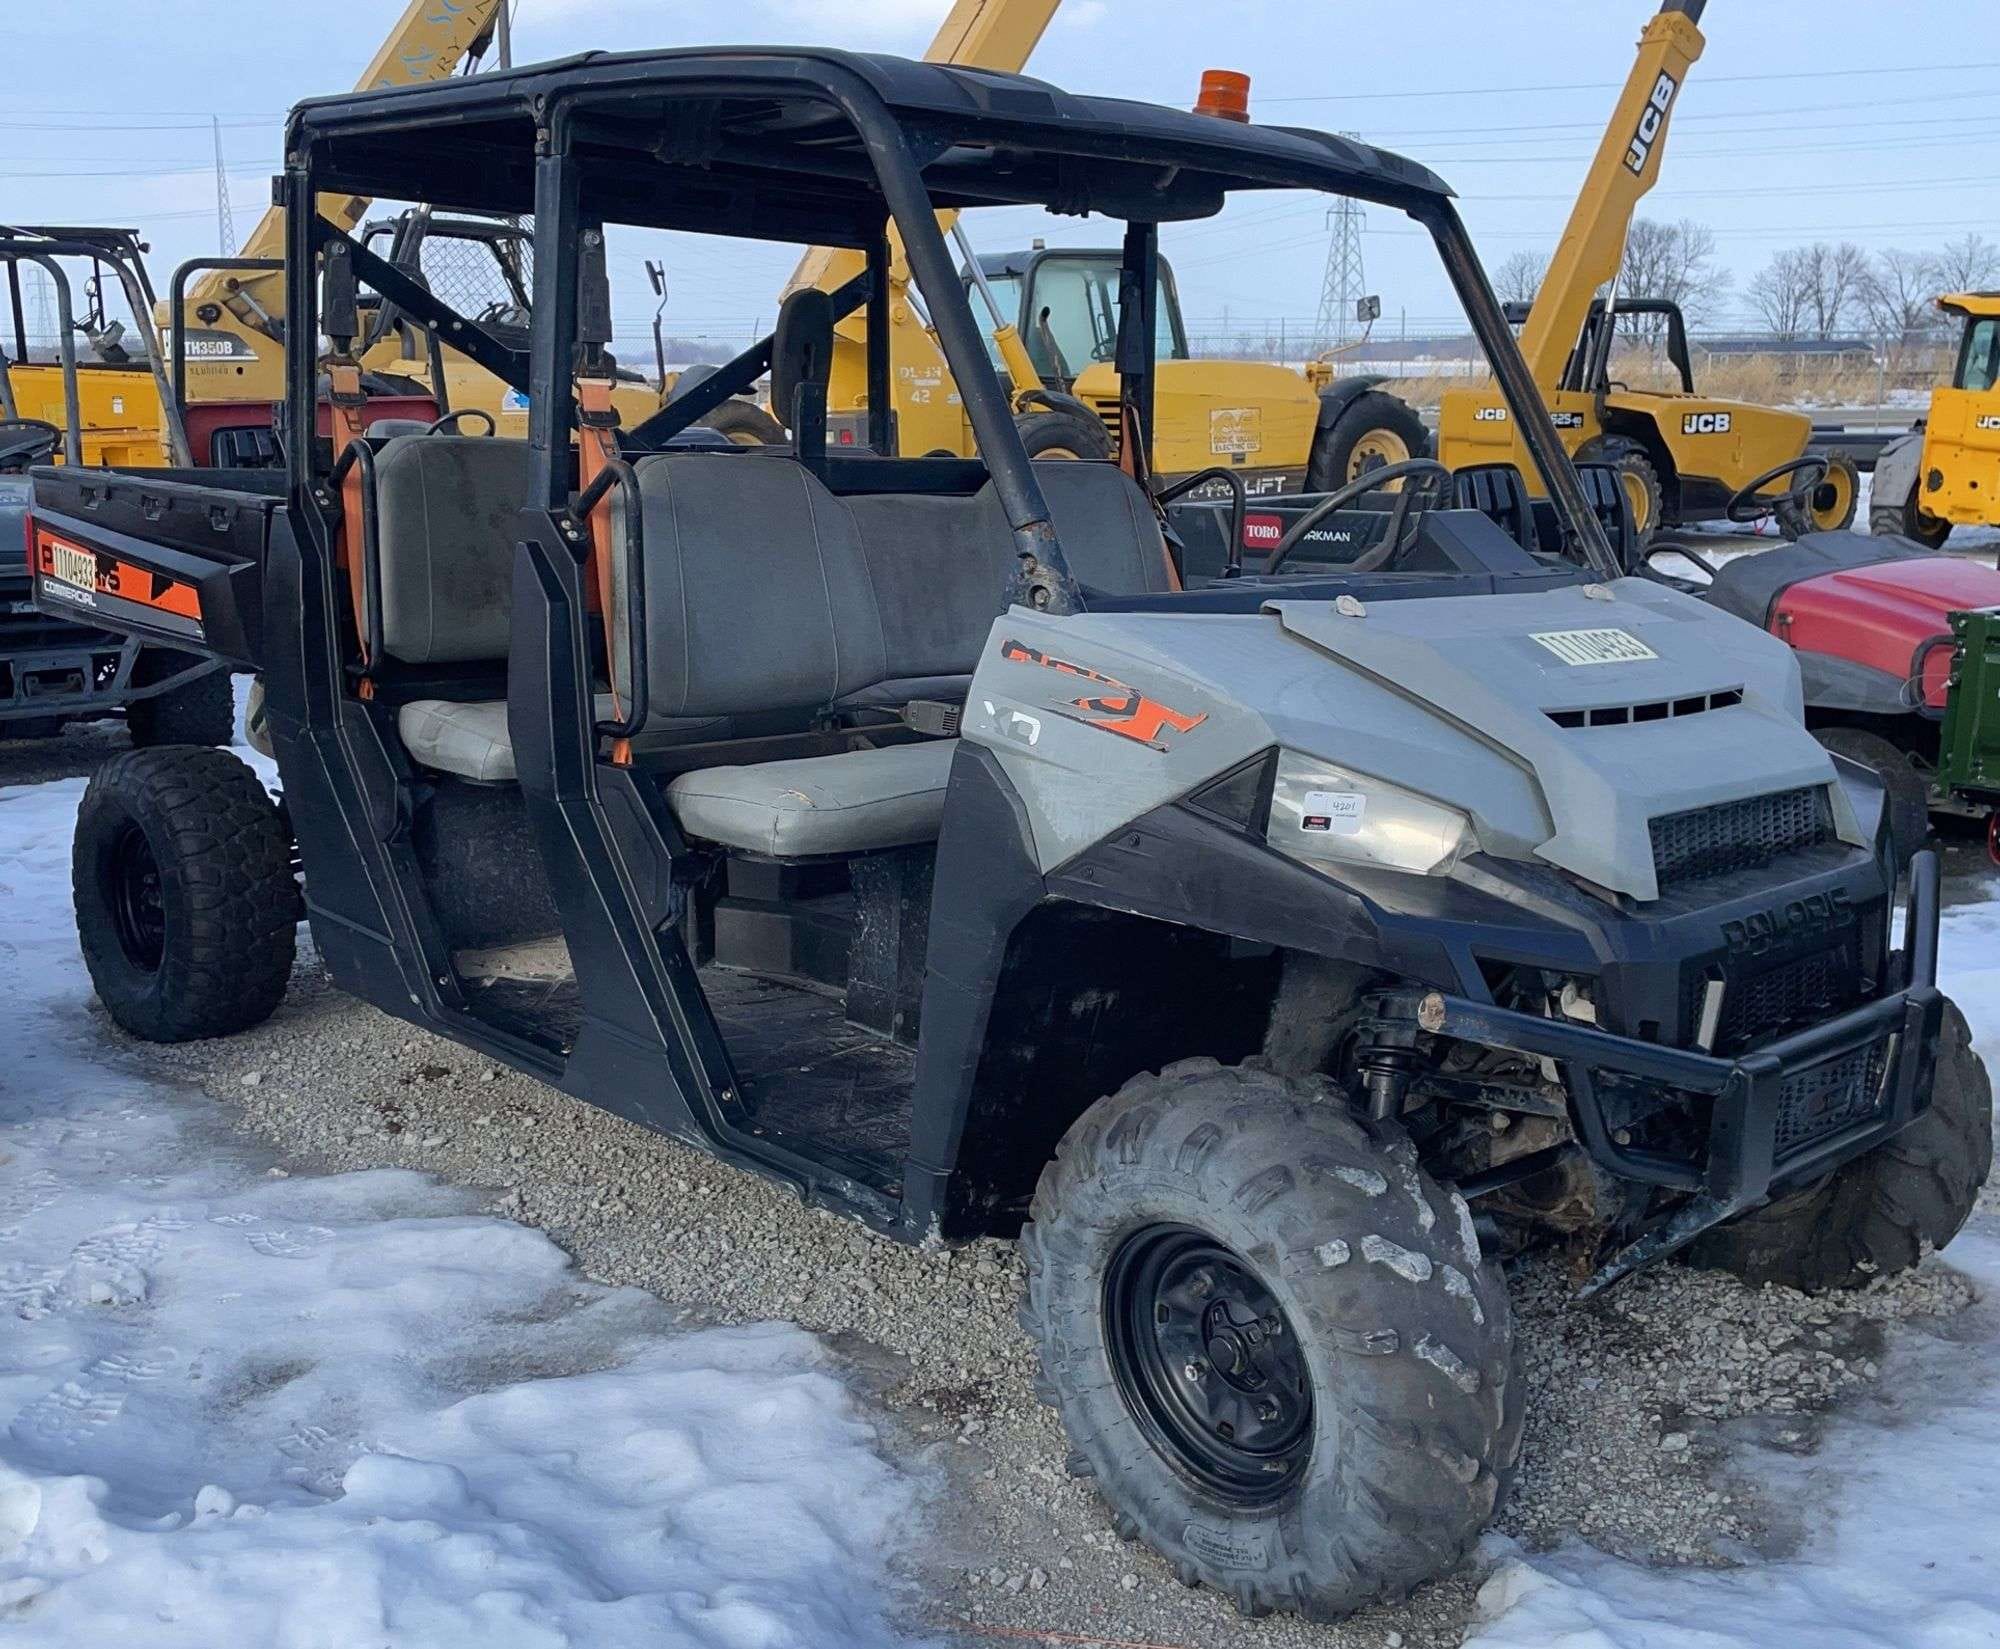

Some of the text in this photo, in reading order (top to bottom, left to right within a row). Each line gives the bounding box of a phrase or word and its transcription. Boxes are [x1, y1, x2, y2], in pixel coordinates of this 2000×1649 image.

[1625, 74, 1676, 172] JCB
[184, 341, 233, 355] TH350B
[911, 389, 930, 403] 42
[1475, 409, 1506, 420] JCB
[1977, 415, 2000, 428] JC
[1684, 413, 1730, 433] JCB
[1303, 530, 1351, 541] RKMAN
